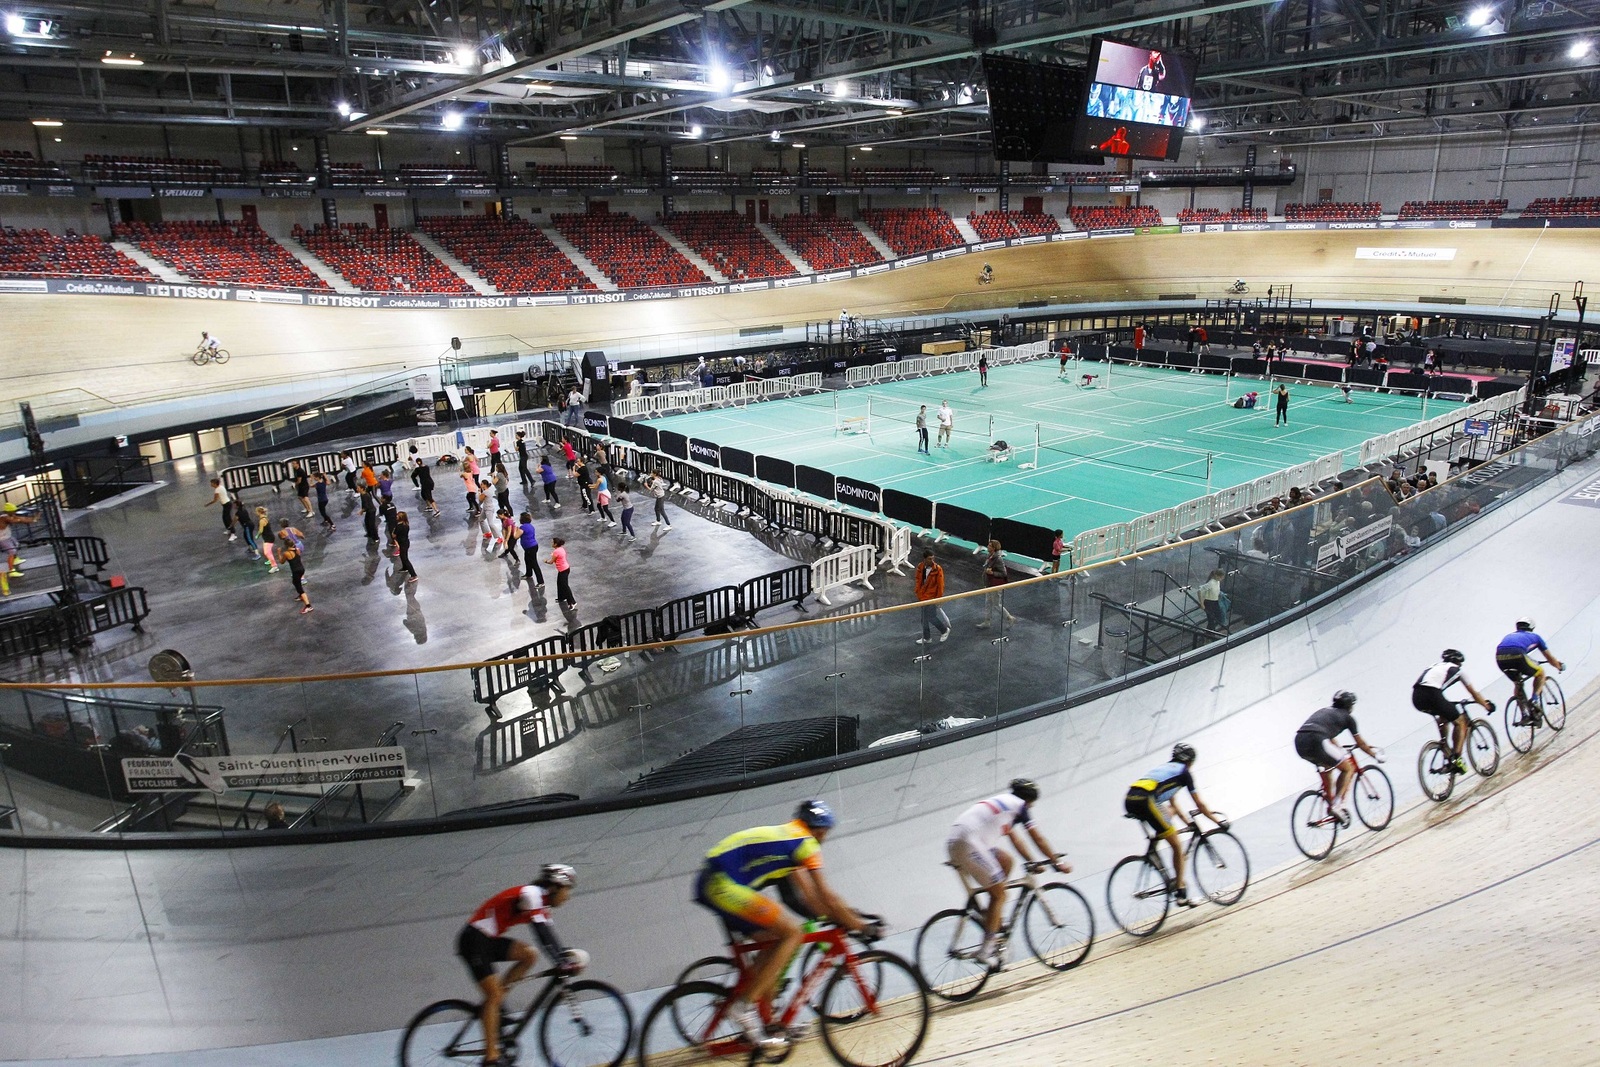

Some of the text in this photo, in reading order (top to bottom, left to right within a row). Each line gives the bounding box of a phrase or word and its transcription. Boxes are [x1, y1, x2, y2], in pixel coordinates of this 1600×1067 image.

[164, 189, 205, 197] SPECIALIZED
[66, 283, 135, 294] Crédit Mutuel
[171, 286, 231, 300] TISSOT
[692, 285, 726, 297] TISSOT
[588, 292, 627, 304] TISSOT
[633, 291, 672, 300] Crédit Mutuel
[329, 296, 380, 308] TISSOT
[389, 299, 440, 308] Crédit Mutuel
[467, 297, 513, 308] TISSOT
[127, 759, 173, 768] FÉDÉRATION
[218, 751, 403, 772] Saint-Quentin-en-Yvelines
[129, 768, 176, 777] FRANÇAISE
[139, 780, 178, 788] CYCLISME
[229, 774, 304, 787] Communauté
